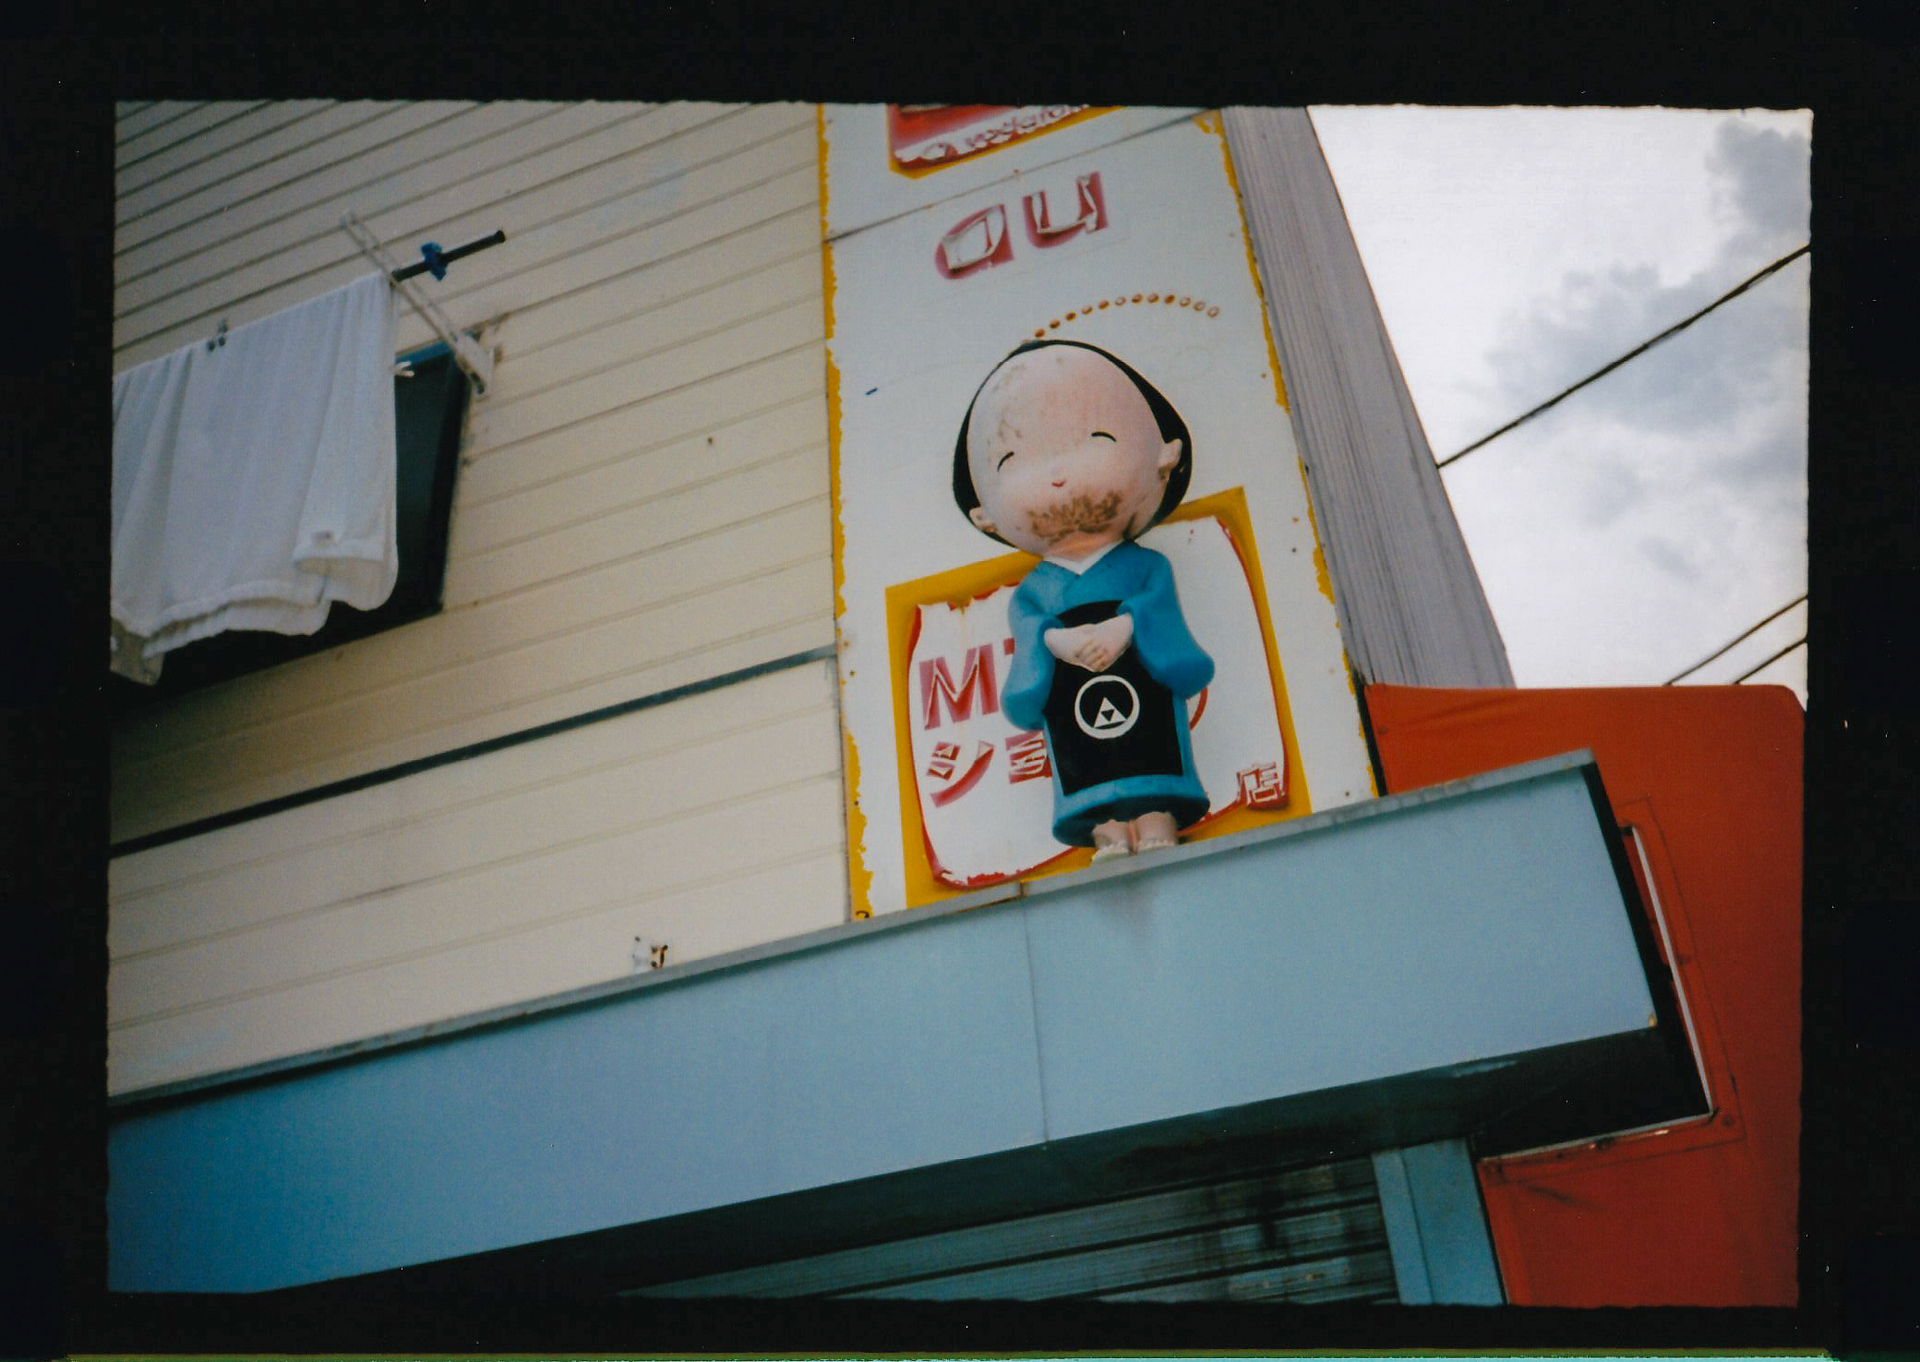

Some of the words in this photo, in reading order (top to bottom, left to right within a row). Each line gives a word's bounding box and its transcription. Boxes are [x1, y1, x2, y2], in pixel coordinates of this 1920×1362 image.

[935, 172, 1108, 280] au
[919, 637, 1014, 731] M
[1236, 761, 1285, 807] 店
